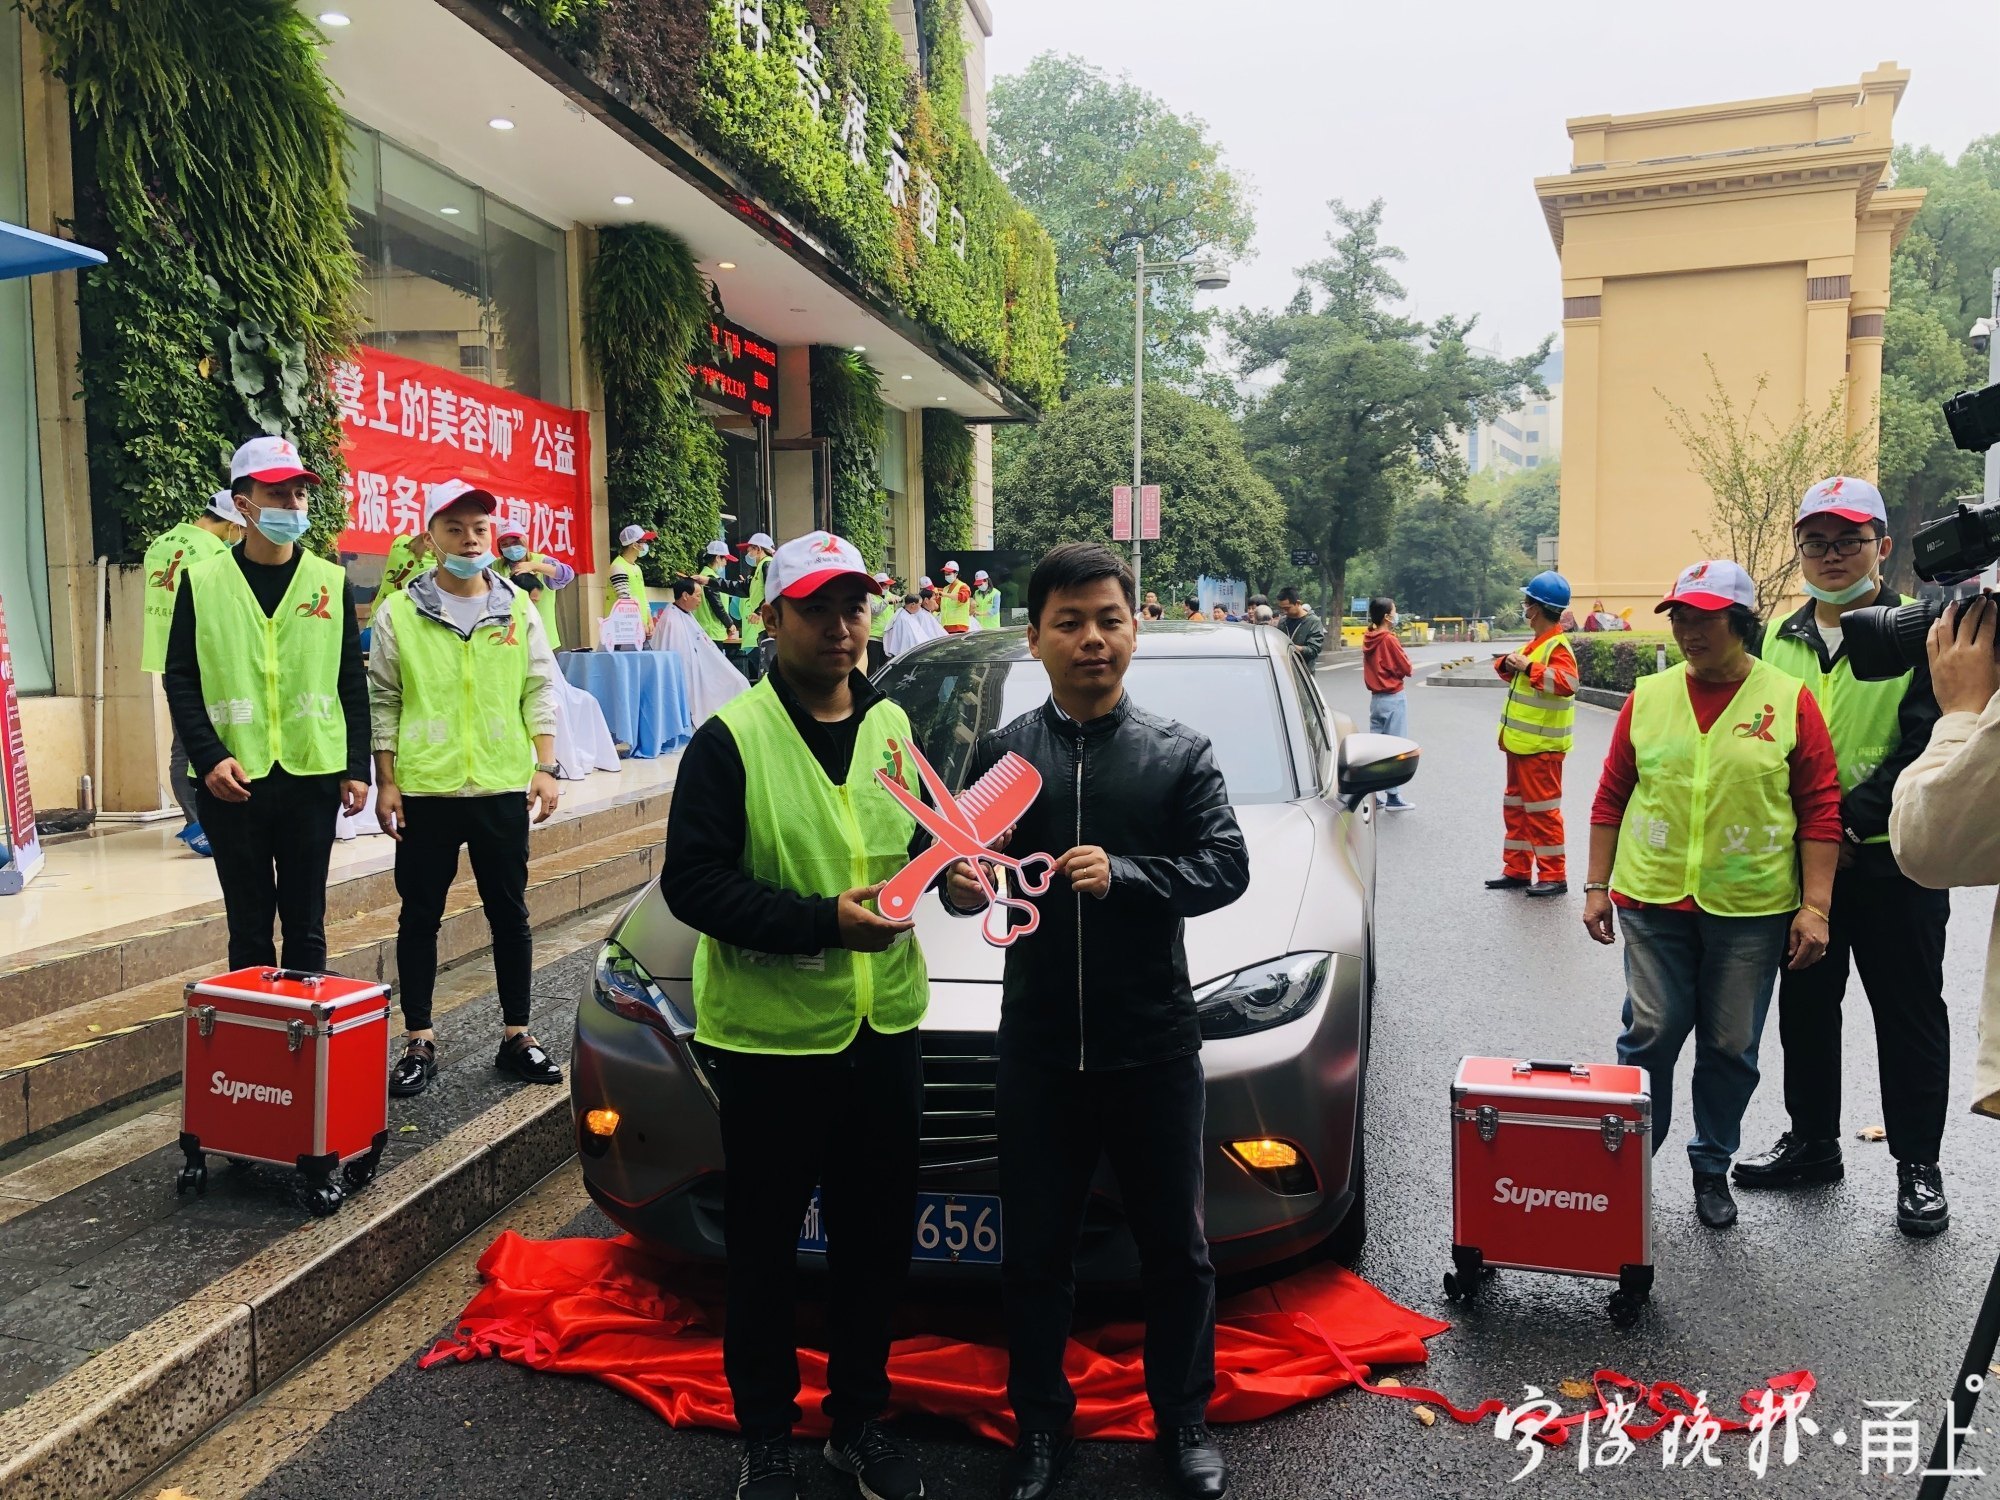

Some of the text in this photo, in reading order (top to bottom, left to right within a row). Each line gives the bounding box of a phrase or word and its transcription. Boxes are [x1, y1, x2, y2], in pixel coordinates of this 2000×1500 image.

[1721, 824, 1783, 854] 义工
[210, 1070, 293, 1106] Supreme
[1493, 1177, 1609, 1213] Supreme
[916, 1203, 997, 1252] 656
